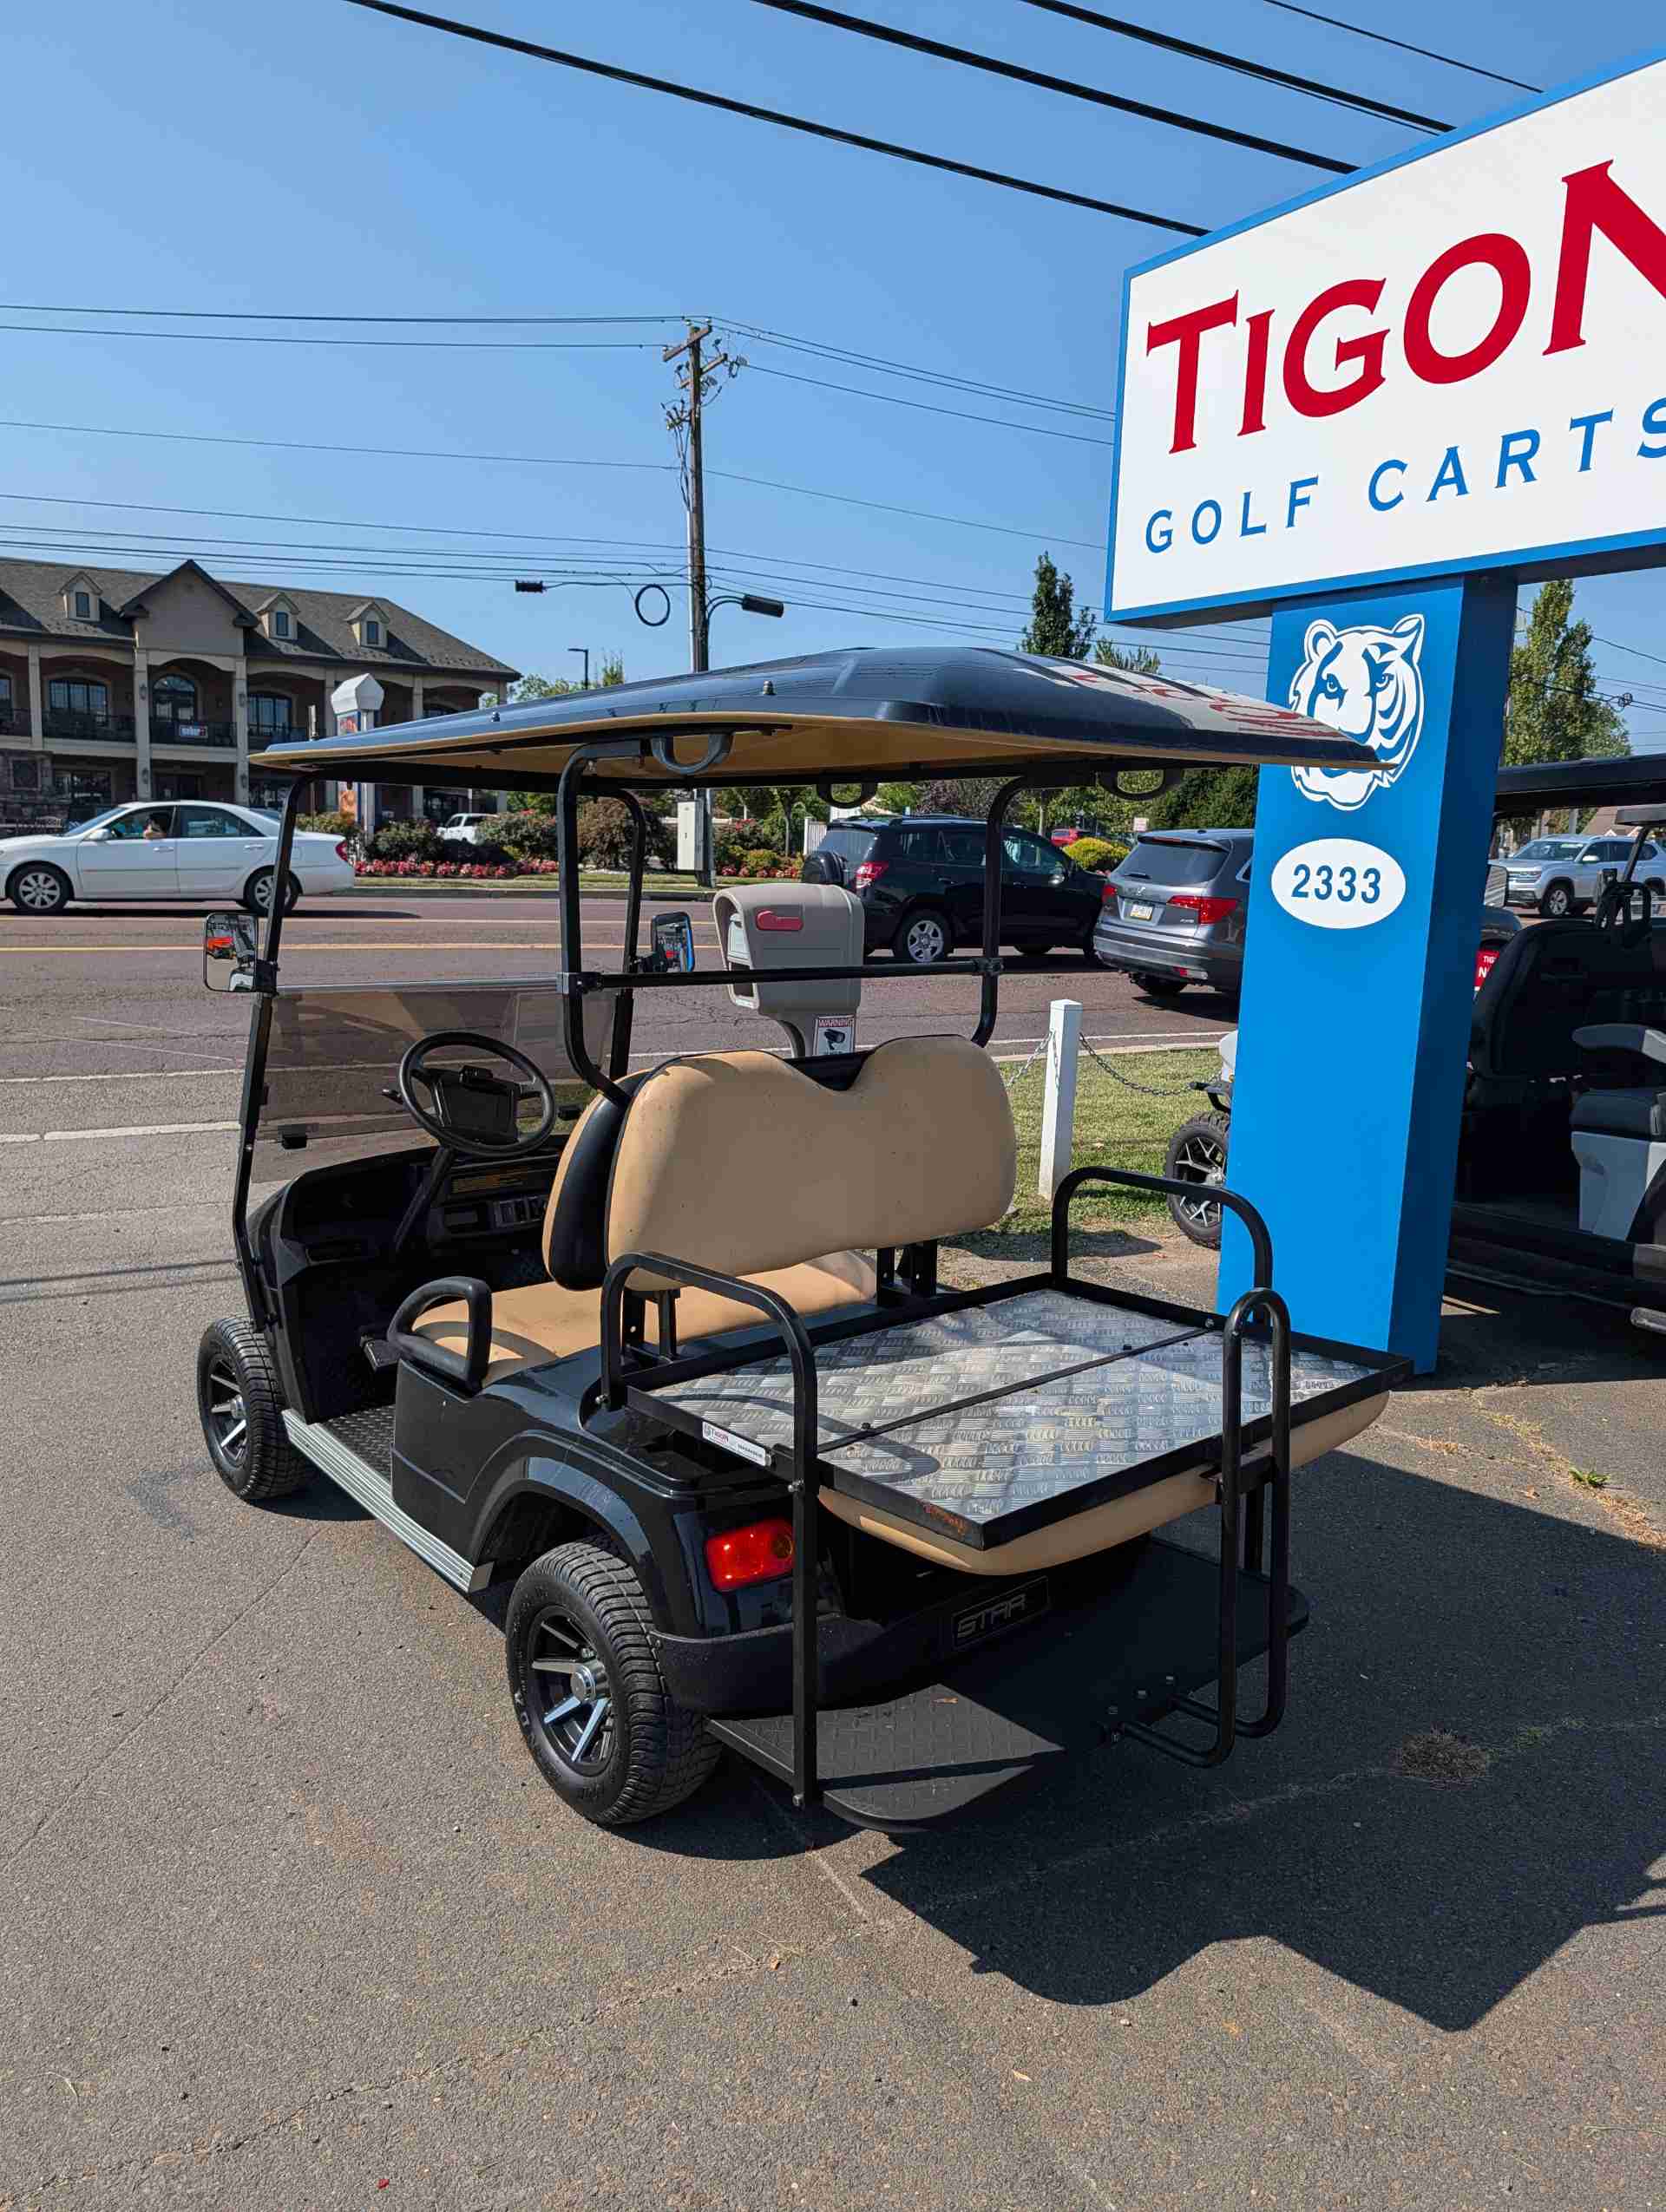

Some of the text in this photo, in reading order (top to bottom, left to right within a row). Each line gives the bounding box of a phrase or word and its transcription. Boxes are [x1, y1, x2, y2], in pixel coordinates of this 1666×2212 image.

[1146, 159, 1666, 454] TIGON
[1145, 396, 1666, 553] GOLF CARTS
[1290, 863, 1381, 904] 2333
[818, 1018, 854, 1028] WARNING
[957, 1594, 1026, 1639] STAR
